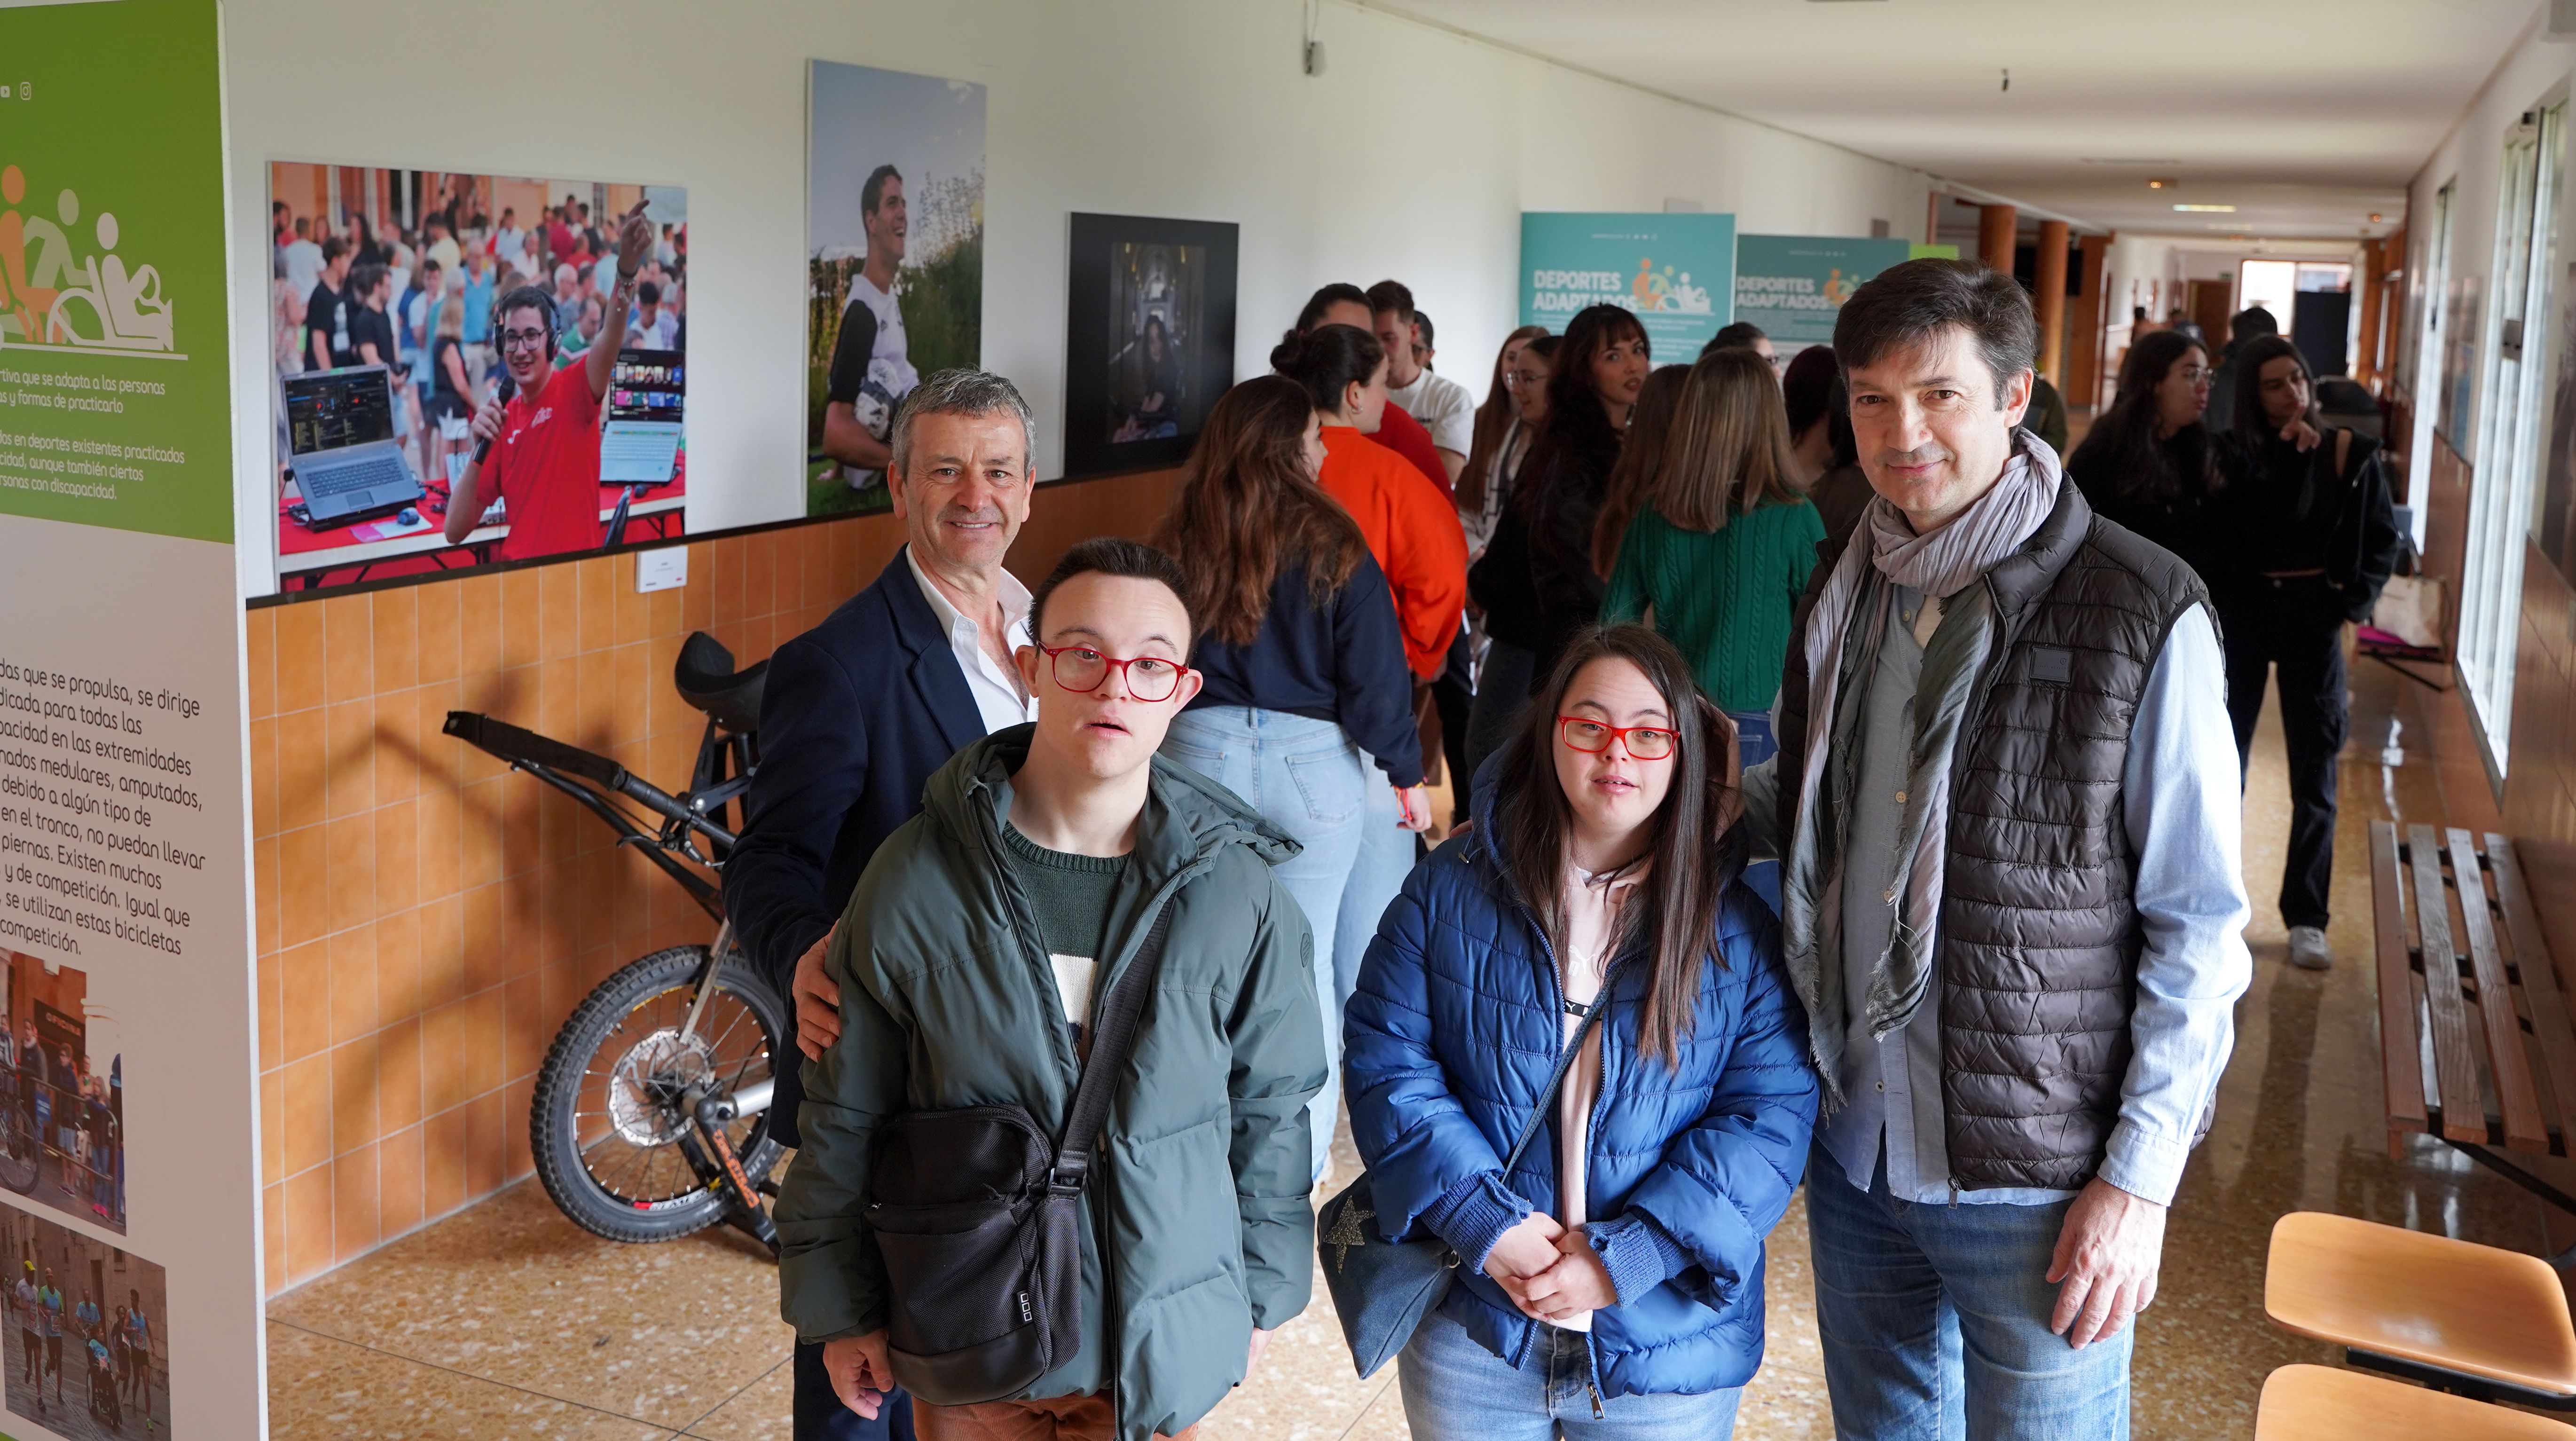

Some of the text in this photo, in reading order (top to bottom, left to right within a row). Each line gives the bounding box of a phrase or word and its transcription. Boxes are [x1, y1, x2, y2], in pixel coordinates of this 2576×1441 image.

[1534, 270, 1621, 291] DEPORTES
[1736, 276, 1814, 293] DEPORTES
[1736, 293, 1828, 310] ADAPTADOS
[9, 393, 16, 407] y
[17, 389, 52, 407] formas
[54, 393, 66, 408] de
[68, 396, 123, 413] practicarlo
[23, 372, 40, 386] que
[42, 374, 53, 386] se
[55, 372, 91, 390] adapta
[93, 378, 100, 389] a
[102, 375, 117, 391] las
[119, 380, 165, 395] personas
[14, 435, 26, 446] en
[28, 433, 70, 451] deportes
[72, 439, 122, 457] existentes
[124, 446, 185, 464] practicados
[30, 458, 64, 473] aunque
[67, 460, 107, 476] también
[110, 464, 144, 481] ciertos
[31, 479, 48, 491] con
[50, 478, 117, 500] discapacidad.
[24, 669, 47, 687] que
[52, 673, 65, 689] se
[70, 677, 133, 705] propulsa,
[138, 690, 153, 707] se
[157, 688, 199, 718] dirige
[45, 701, 77, 721] para
[80, 705, 118, 730] todas
[122, 711, 141, 735] las
[52, 732, 68, 748] en
[72, 731, 91, 754] las
[96, 741, 191, 776] extremidades
[2, 774, 151, 827] debido a algún tipo de
[41, 758, 114, 791] medulares,
[119, 777, 202, 811] amputados,
[1, 807, 205, 870] en el tronco, no puedan llevar
[2, 833, 161, 890] piernas. Existen muchos
[5, 863, 190, 927] y de competición. Igual que
[0, 919, 81, 955] competición.
[6, 892, 181, 955] se utilizan estas bicicletas
